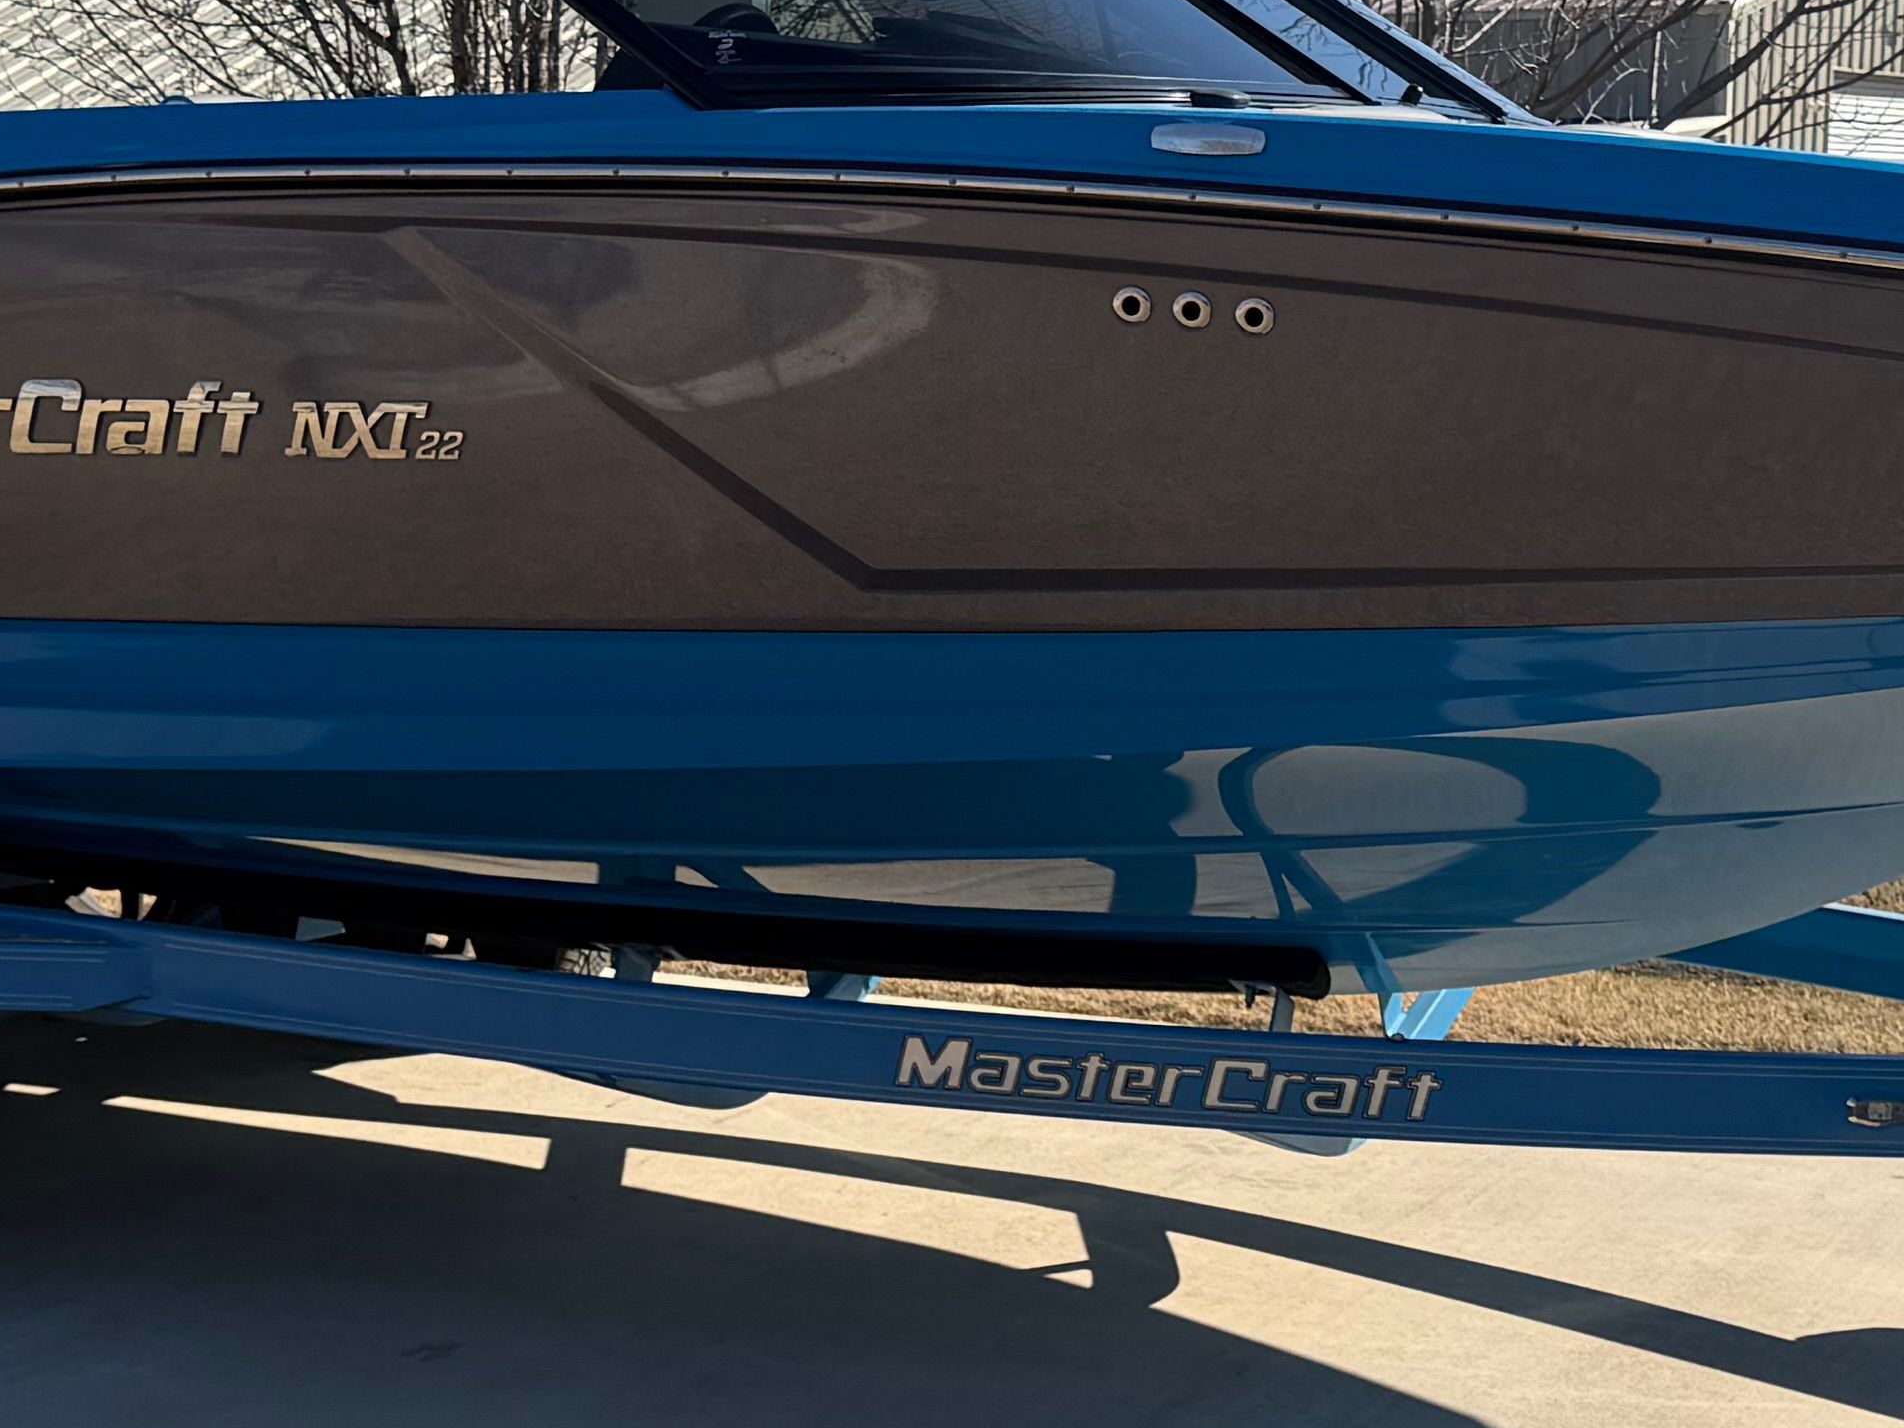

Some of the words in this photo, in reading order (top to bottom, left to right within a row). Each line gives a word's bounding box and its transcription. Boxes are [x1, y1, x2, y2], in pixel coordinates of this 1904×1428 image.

[285, 401, 429, 459] NXT
[414, 431, 464, 460] 22
[896, 1035, 1441, 1121] MasterCraft
